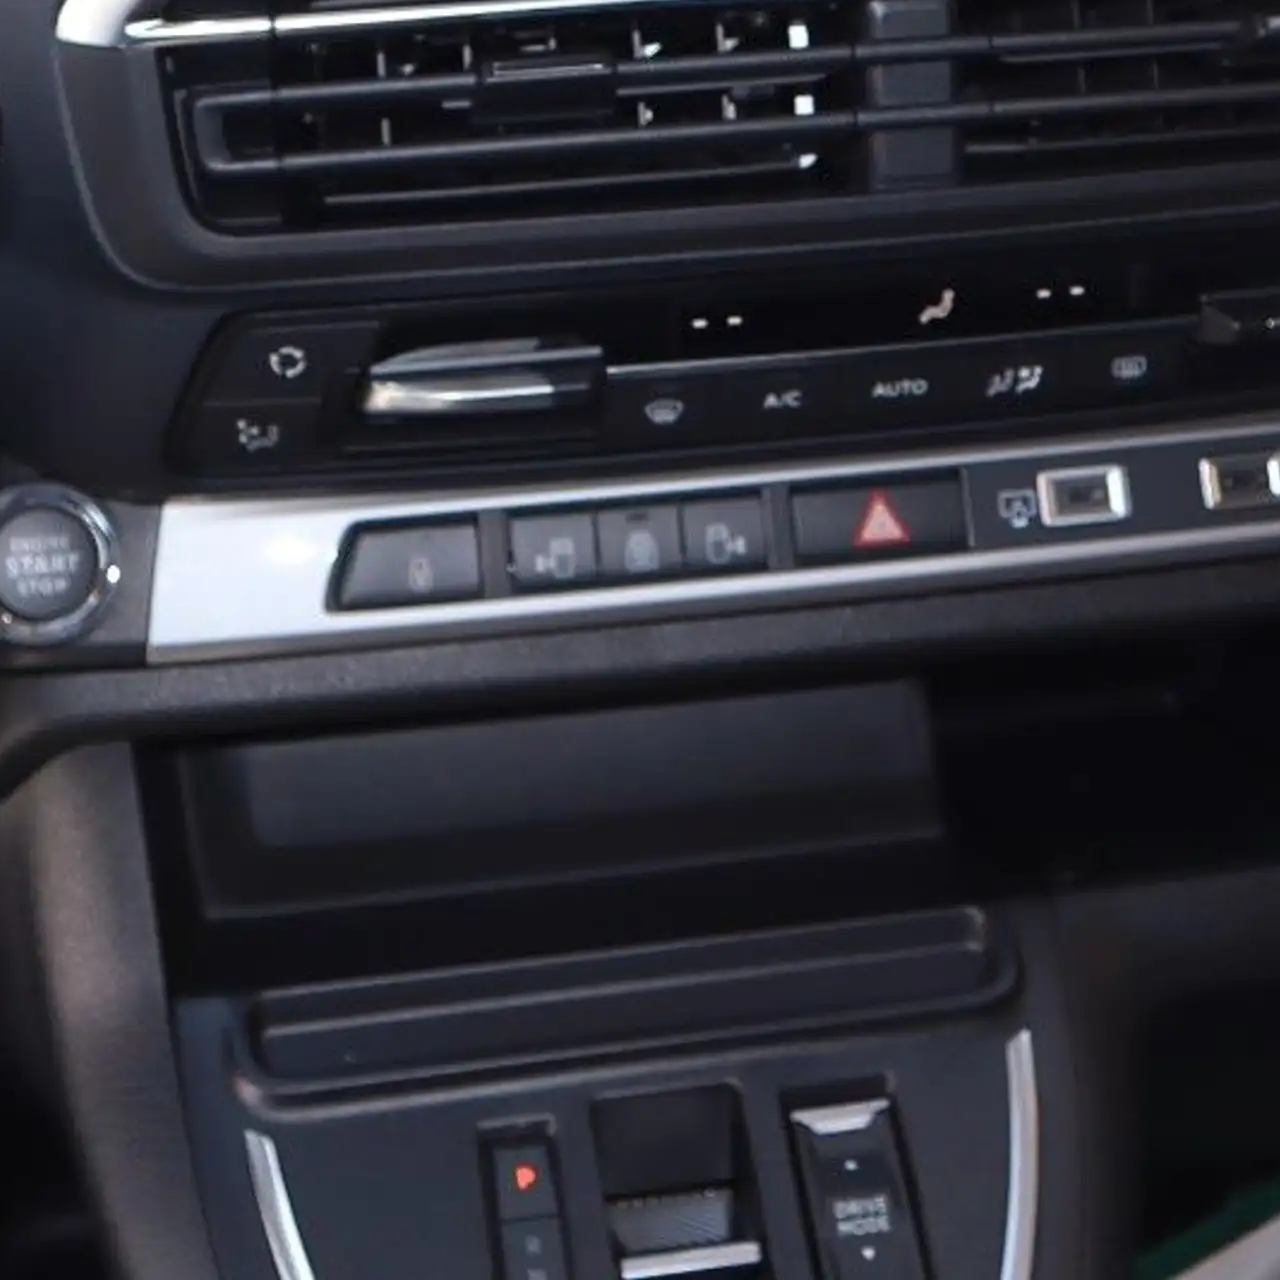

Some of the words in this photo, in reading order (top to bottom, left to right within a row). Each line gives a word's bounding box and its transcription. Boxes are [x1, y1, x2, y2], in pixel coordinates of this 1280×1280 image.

[872, 377, 930, 398] AUTO
[763, 389, 803, 410] A/C
[5, 552, 80, 578] START
